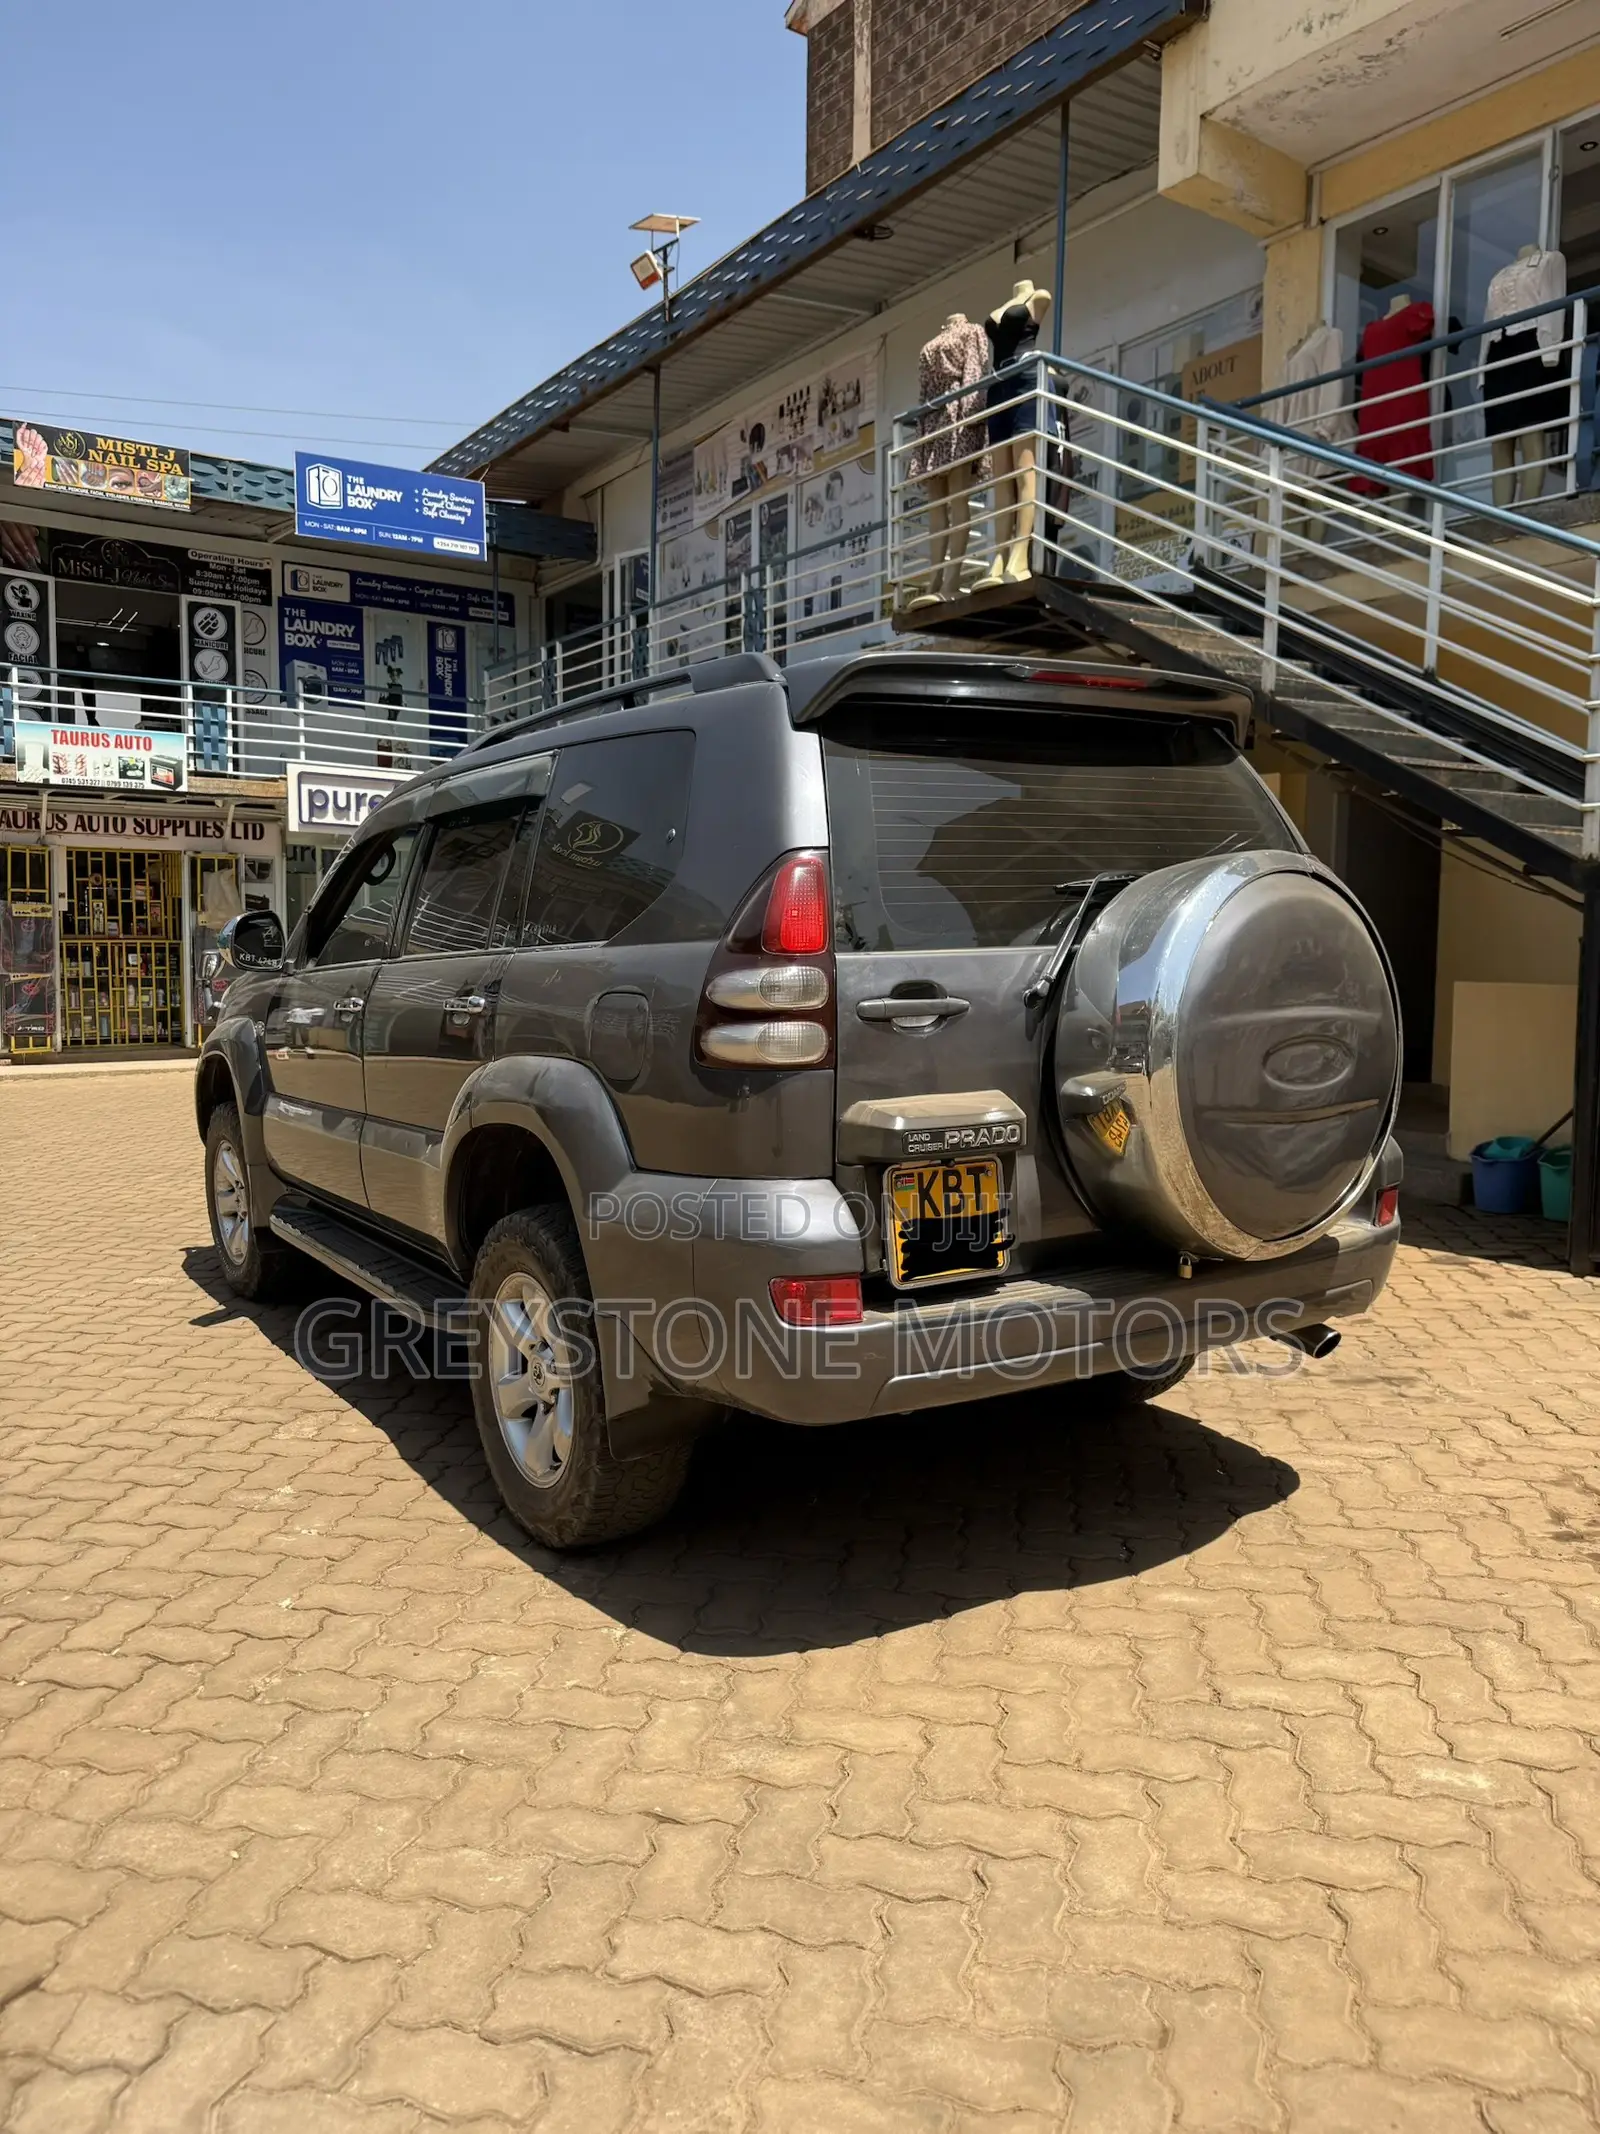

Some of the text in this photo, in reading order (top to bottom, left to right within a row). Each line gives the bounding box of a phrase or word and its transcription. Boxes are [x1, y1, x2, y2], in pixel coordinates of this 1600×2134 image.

[1191, 355, 1239, 386] ABOUT
[95, 436, 175, 462] MISTI-J
[88, 449, 140, 469] NAIL
[146, 459, 184, 476] SPA
[347, 475, 364, 484] THE
[347, 485, 403, 503] LAUNDRY
[421, 488, 475, 505] Laundry Services
[347, 496, 374, 510] BOX
[445, 501, 472, 516] Cleaning
[191, 551, 264, 568] Operating Hours
[209, 562, 226, 571] Mon
[233, 566, 246, 574] Sat
[189, 578, 223, 590] Sundays
[233, 584, 267, 596] Holidays
[312, 579, 343, 589] LAUNDRY
[10, 609, 36, 620] WAXING
[284, 607, 306, 618] THE
[284, 617, 356, 637] LAUNDRY
[194, 638, 228, 650] MANICURE
[284, 632, 317, 648] BOX
[8, 652, 38, 664] FACIAL
[436, 656, 444, 676] BOX
[51, 729, 152, 752] TAURUS AUTO
[74, 814, 126, 834] AUTO
[133, 817, 224, 839] SUPPLIES
[231, 821, 265, 841] LTD
[908, 1133, 931, 1142] LAND
[908, 1124, 1020, 1153] CRUISER PRADO
[917, 1166, 987, 1218] KBT
